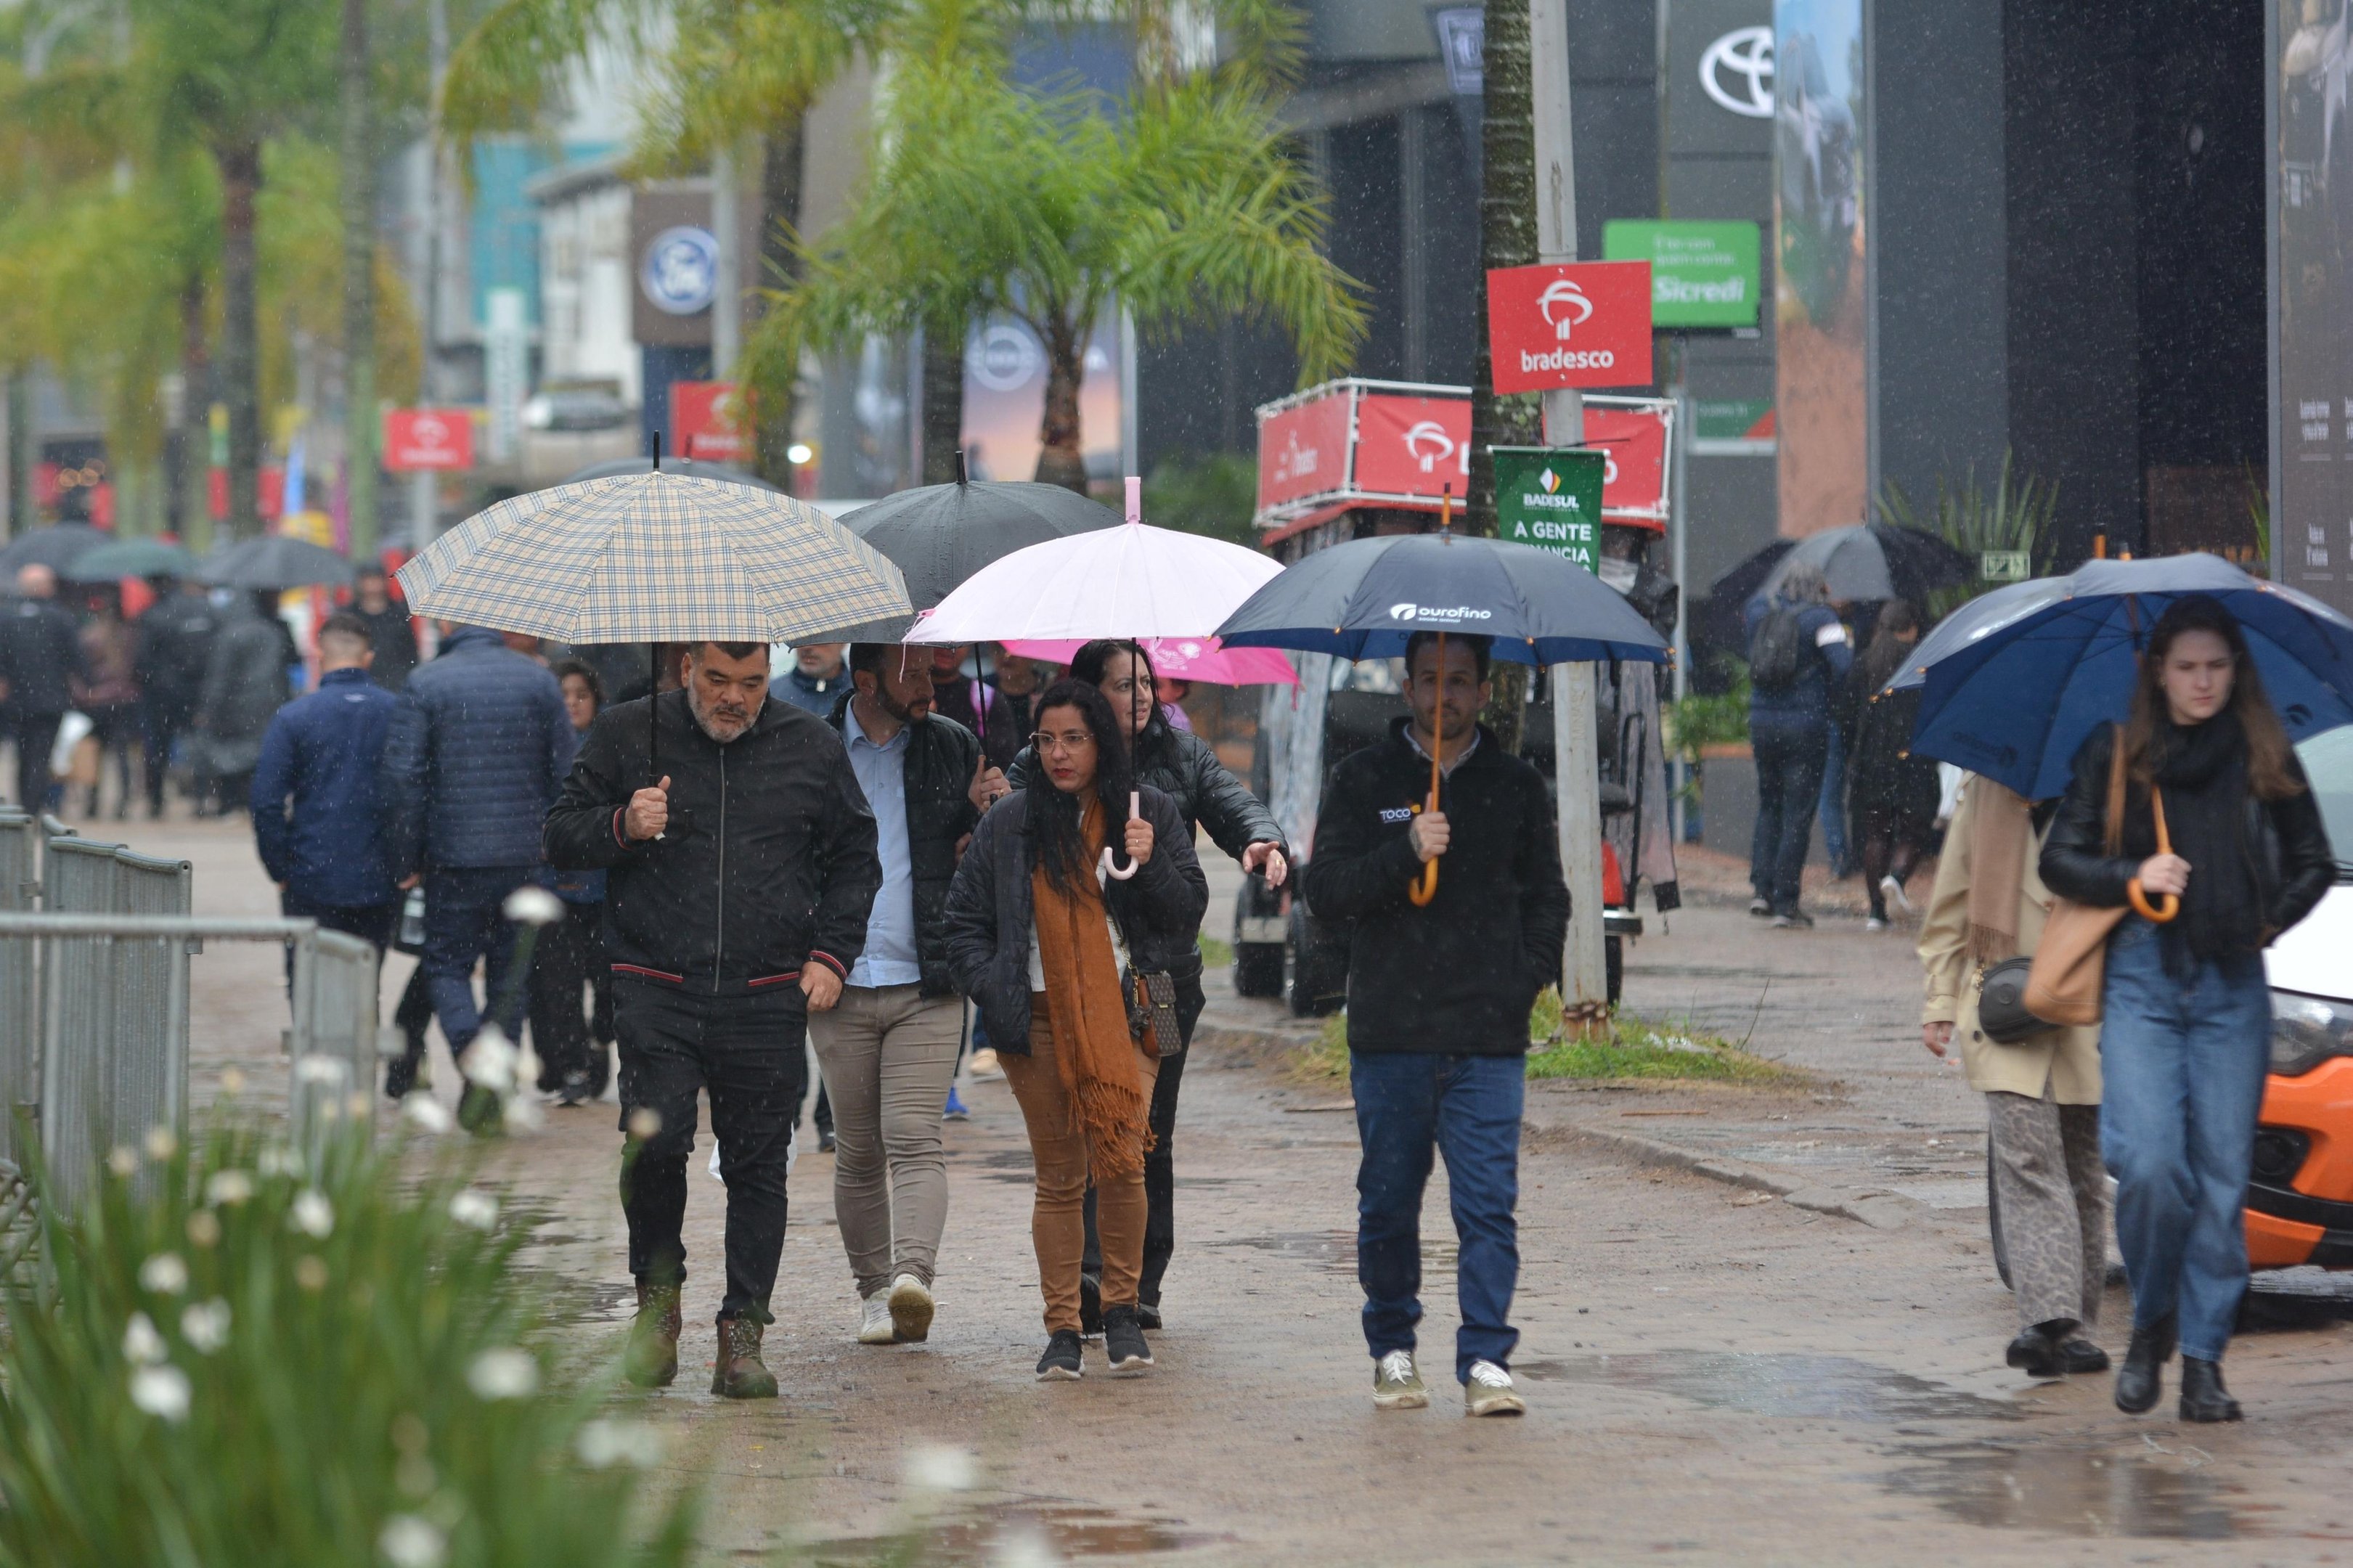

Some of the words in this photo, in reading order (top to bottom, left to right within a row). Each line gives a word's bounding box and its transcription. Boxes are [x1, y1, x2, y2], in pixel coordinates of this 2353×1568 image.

[1655, 276, 1745, 302] Sicredi
[1520, 346, 1614, 372] bradesco
[1523, 494, 1579, 507] BADESUL
[1514, 520, 1528, 538] A
[1533, 520, 1592, 542] GENTE
[1419, 606, 1491, 619] ourofino
[1379, 808, 1411, 820] TOCO
